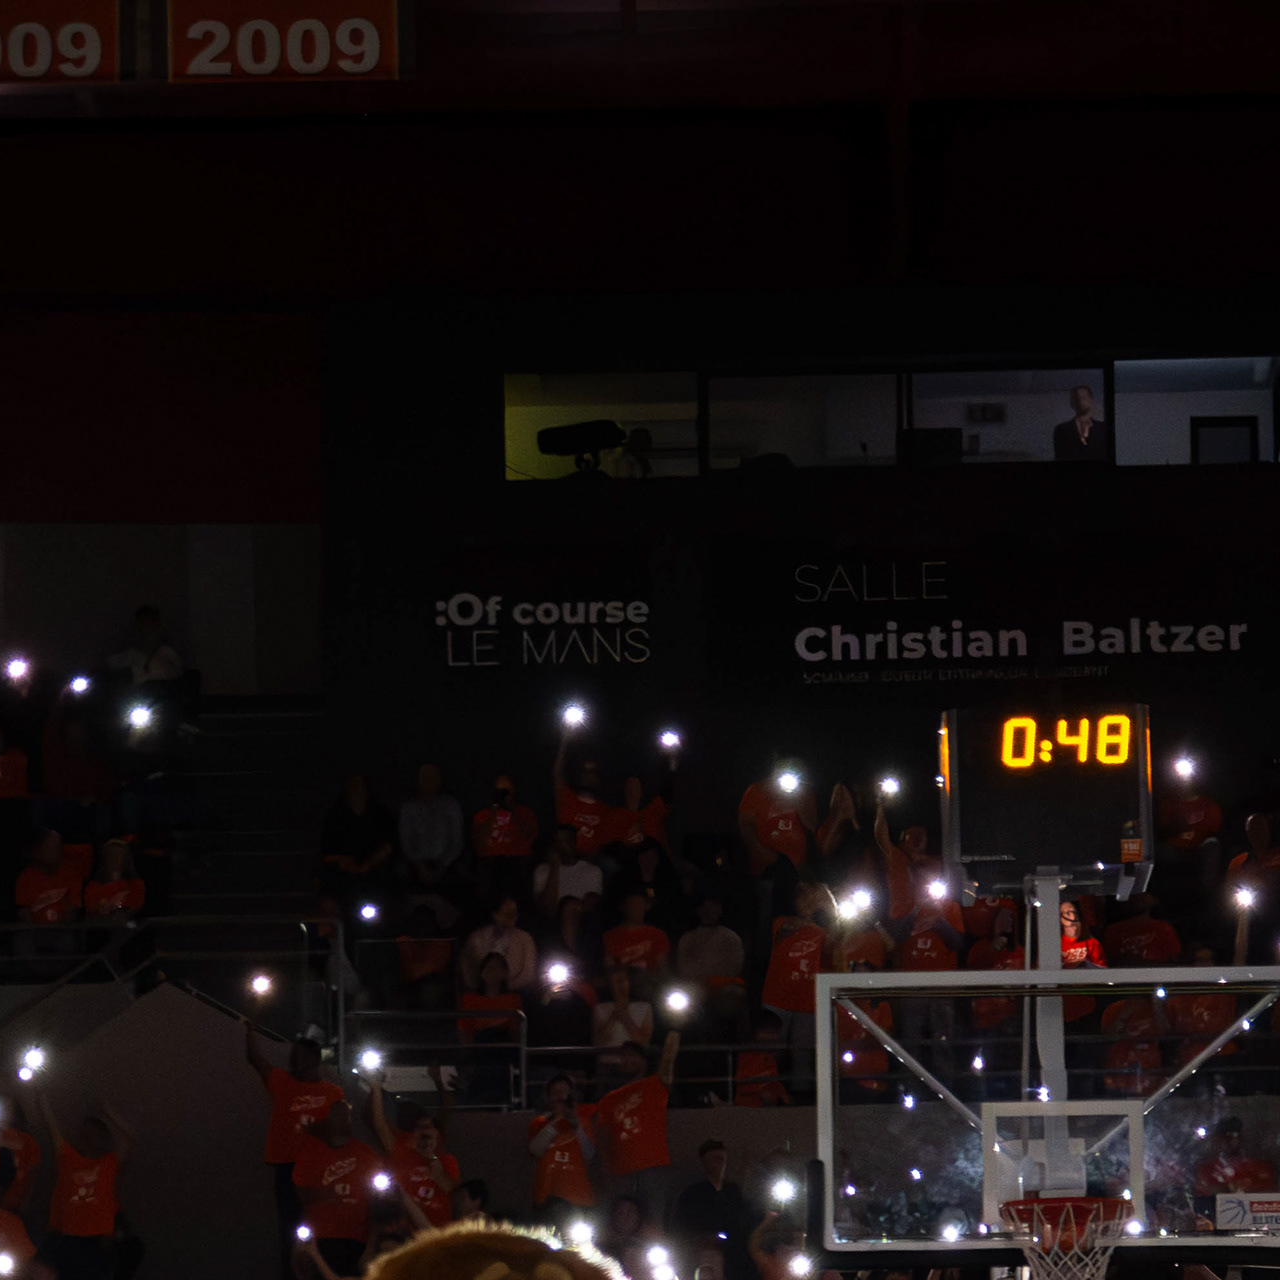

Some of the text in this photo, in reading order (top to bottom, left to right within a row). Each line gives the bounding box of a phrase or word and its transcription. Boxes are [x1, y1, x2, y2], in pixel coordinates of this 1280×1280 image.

[186, 17, 381, 75] 2009
[794, 560, 949, 602] SALLE
[512, 600, 650, 625] course
[446, 627, 651, 667] LE MANS
[793, 617, 1248, 662] Christian Baltzer
[1000, 714, 1131, 768] 0:48
